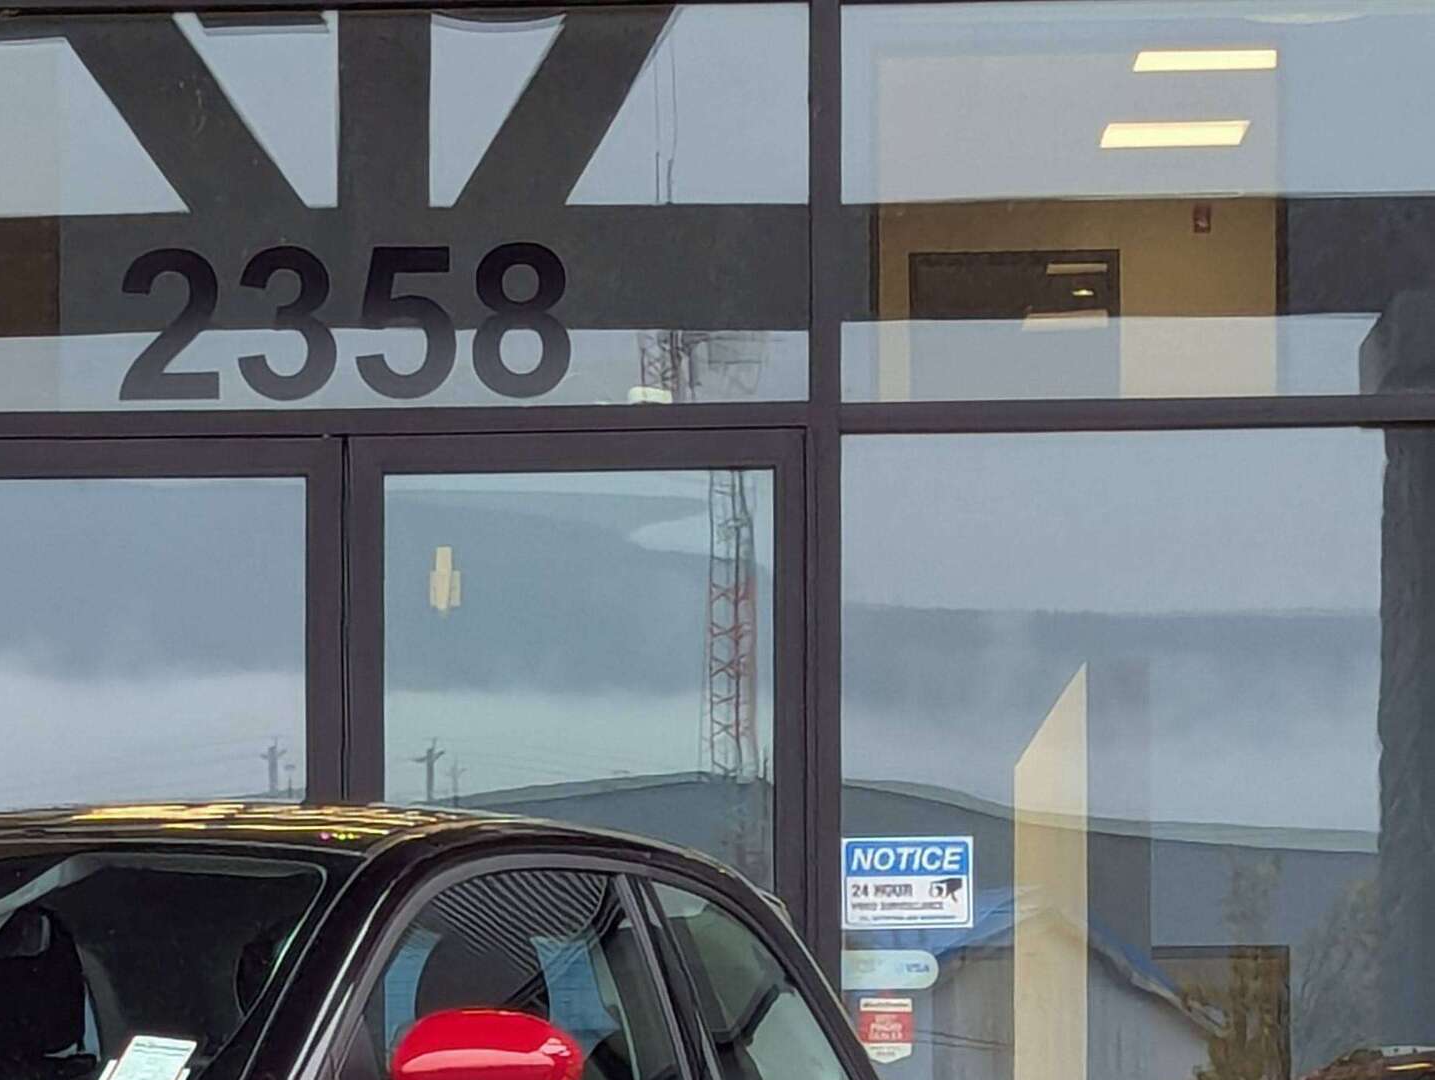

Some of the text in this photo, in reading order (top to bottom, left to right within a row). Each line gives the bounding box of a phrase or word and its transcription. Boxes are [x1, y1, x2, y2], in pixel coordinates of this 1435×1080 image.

[119, 242, 571, 402] 2358
[851, 846, 964, 871] NOTICE
[852, 883, 913, 897] 24 HOUR
